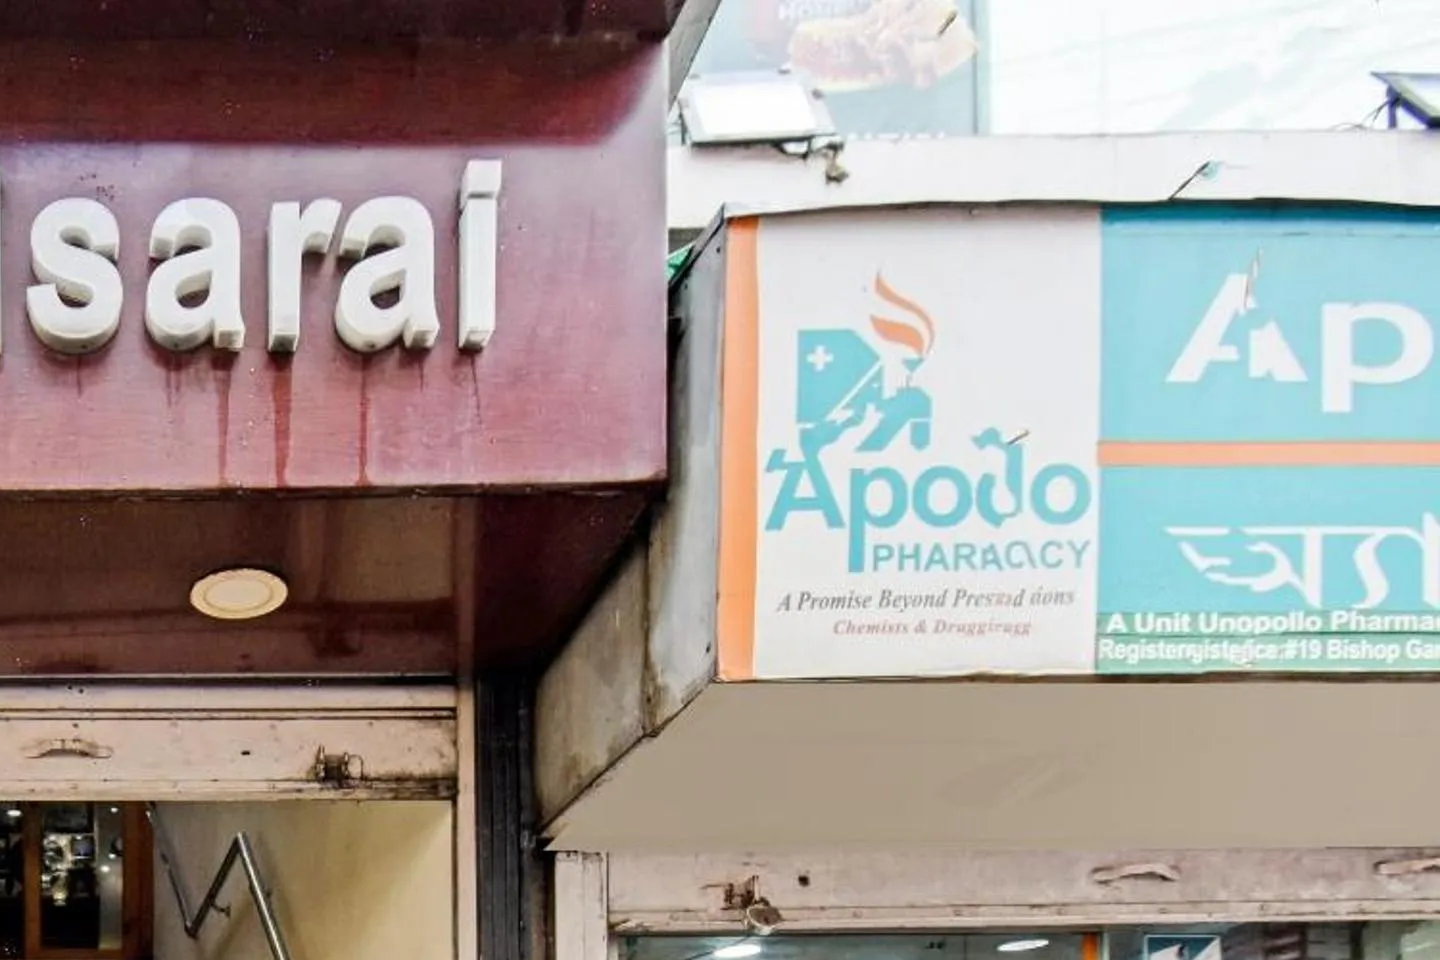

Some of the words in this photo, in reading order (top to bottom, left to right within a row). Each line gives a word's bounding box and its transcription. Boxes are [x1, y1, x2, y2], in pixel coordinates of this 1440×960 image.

[775, 593, 792, 612] A
[797, 590, 873, 611] Promise
[879, 588, 948, 613] Beyond
[833, 619, 909, 636] Chemists
[913, 619, 927, 634] &
[1107, 612, 1128, 633] A
[1134, 612, 1191, 633] Unit
[1326, 638, 1400, 663] Bishop
